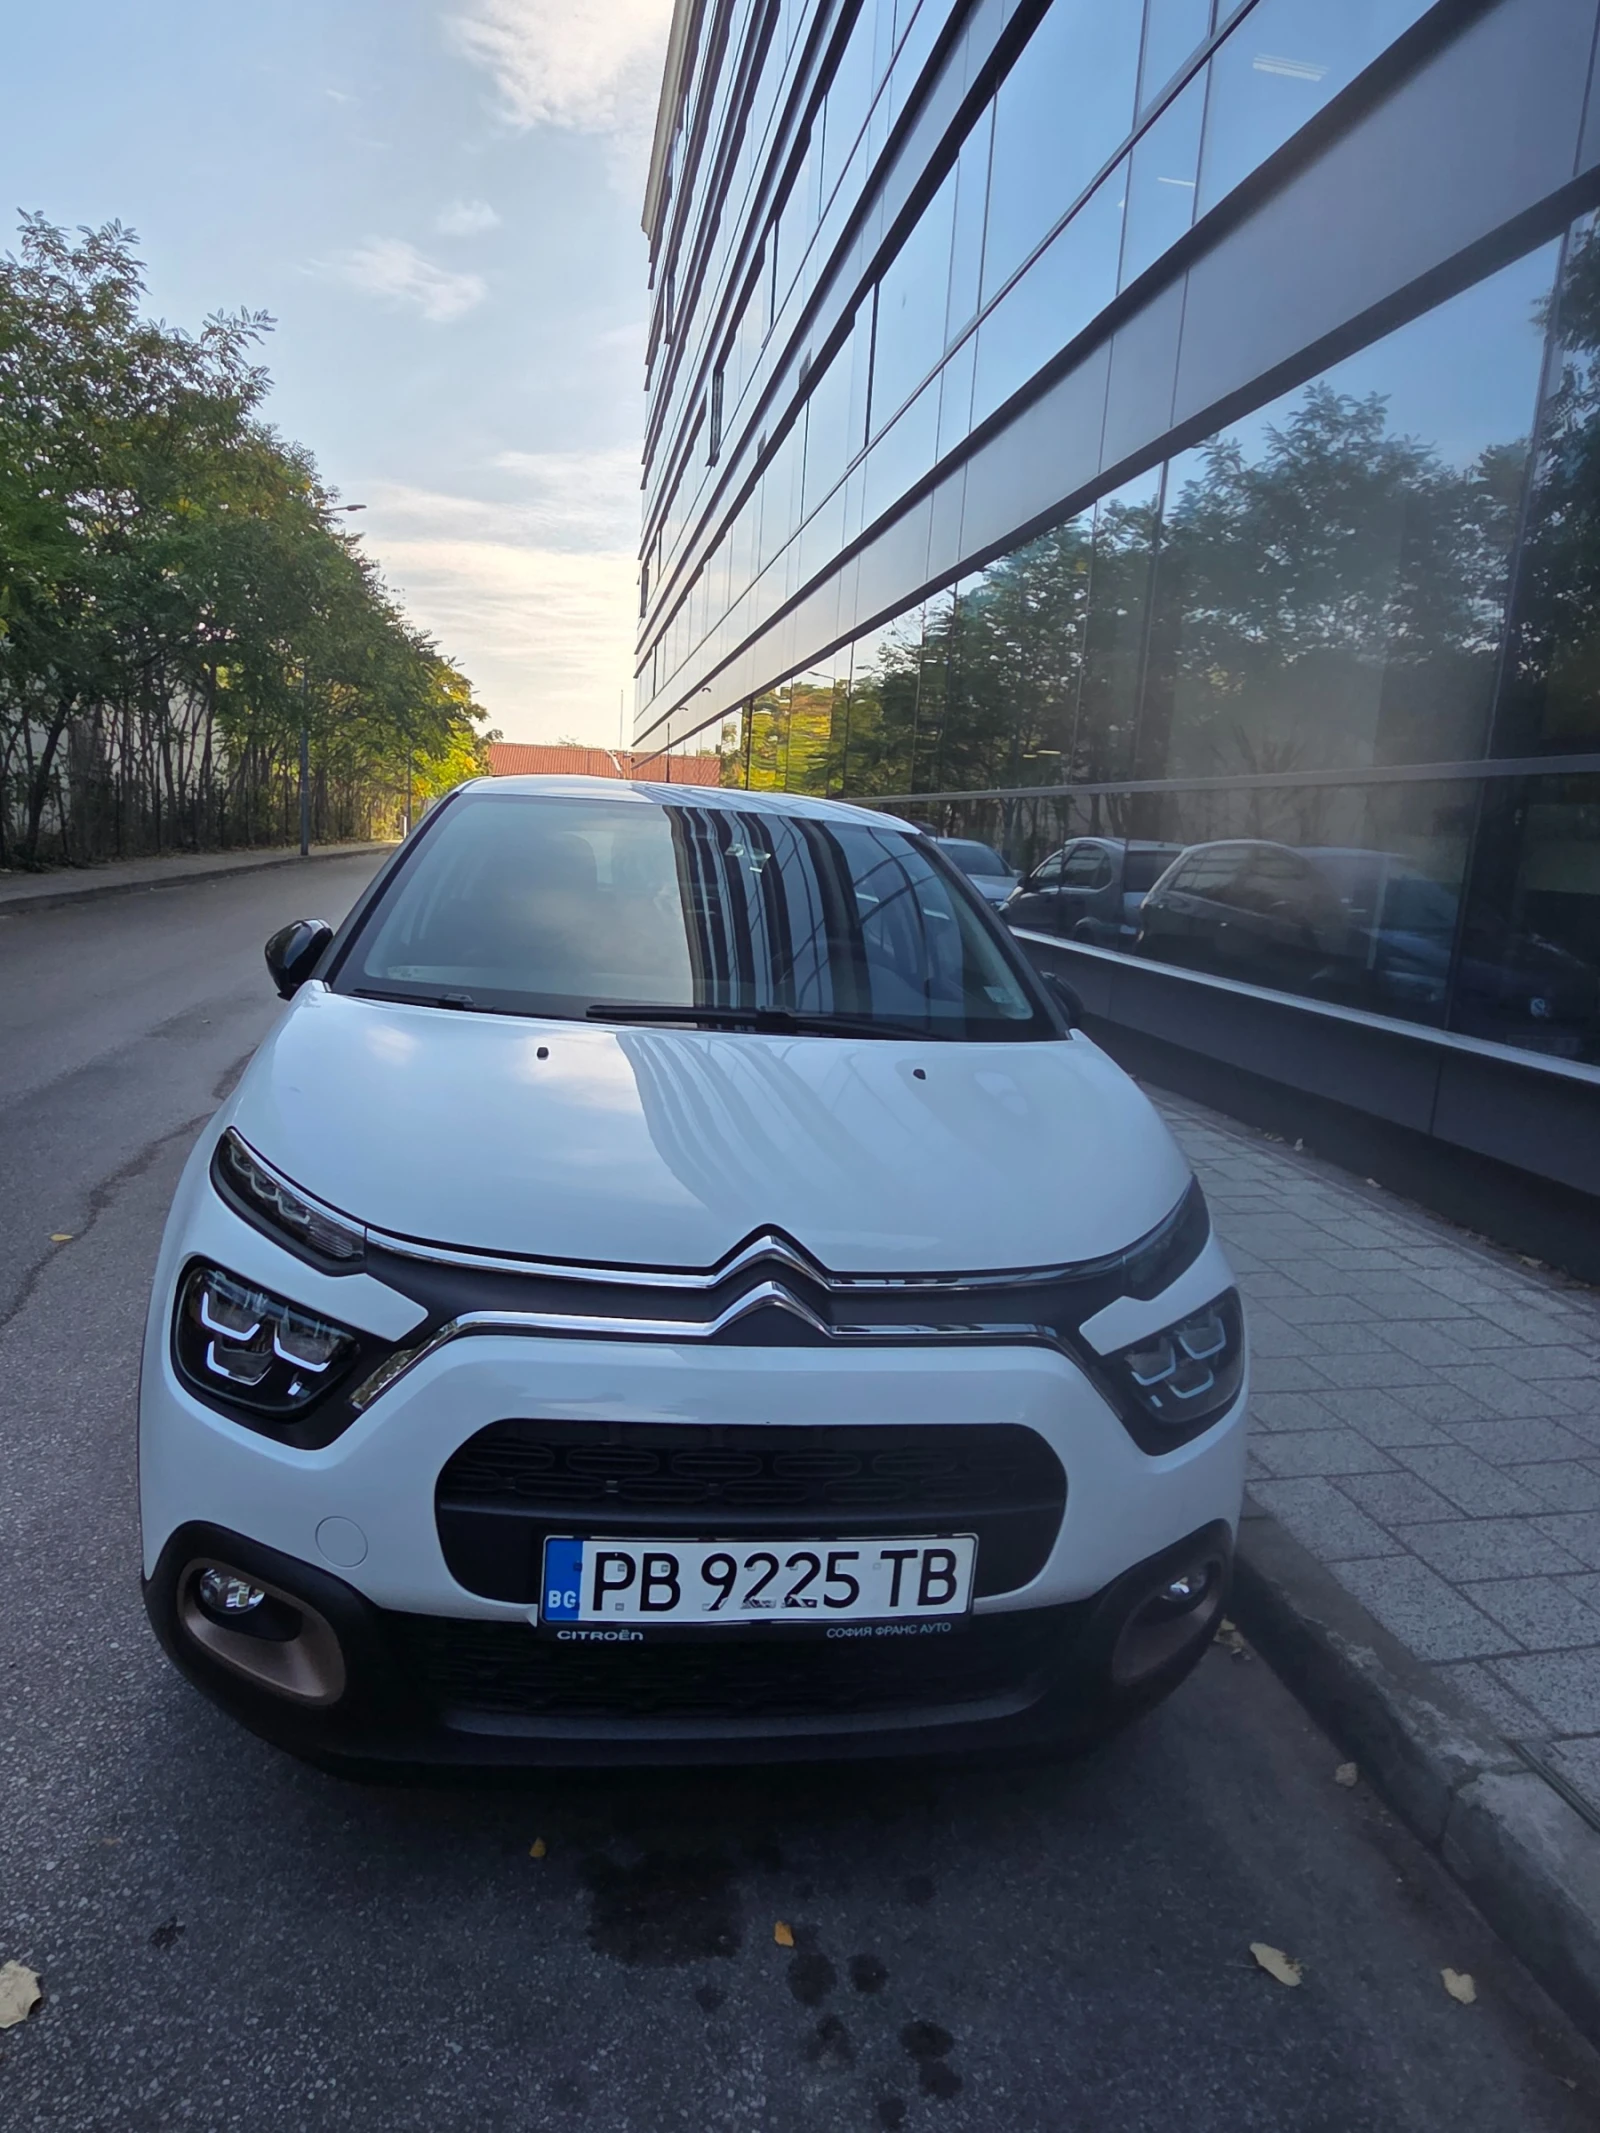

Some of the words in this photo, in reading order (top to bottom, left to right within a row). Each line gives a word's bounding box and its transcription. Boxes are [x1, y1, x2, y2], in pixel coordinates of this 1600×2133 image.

[592, 1551, 681, 1612] PB
[700, 1549, 860, 1611] 9225
[880, 1548, 959, 1608] TB
[548, 1590, 577, 1609] BG
[826, 1627, 872, 1638] СОФИЯ
[875, 1624, 917, 1635] ФРАНС
[920, 1622, 952, 1634] АУТО
